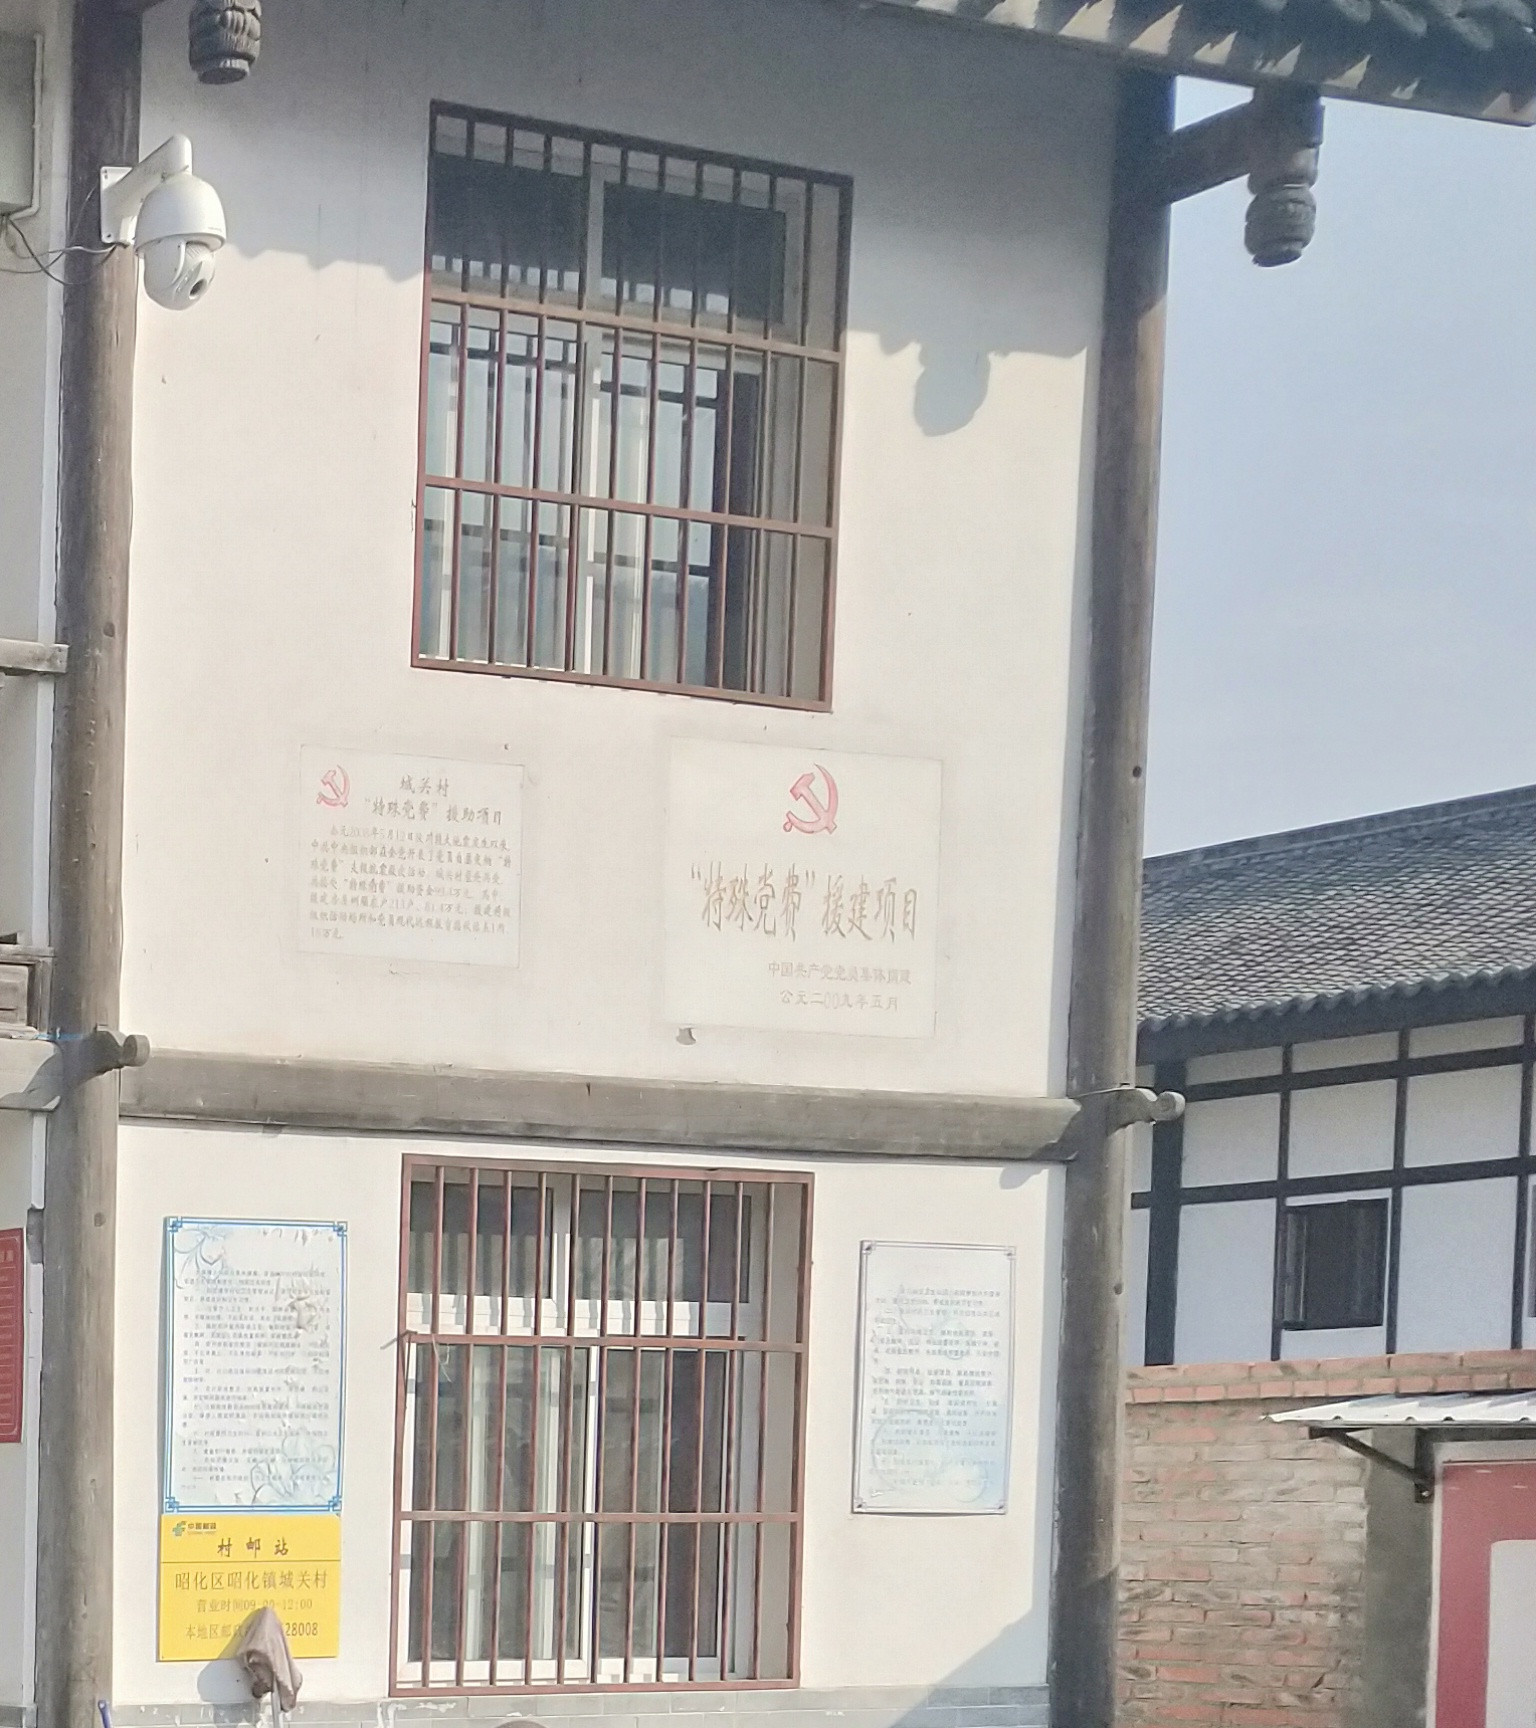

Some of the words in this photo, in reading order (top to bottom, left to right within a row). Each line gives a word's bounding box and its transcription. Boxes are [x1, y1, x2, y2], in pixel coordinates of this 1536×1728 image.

[216, 1536, 290, 1559] 村邮站
[174, 1568, 328, 1591] 昭化区昭化镇城关村
